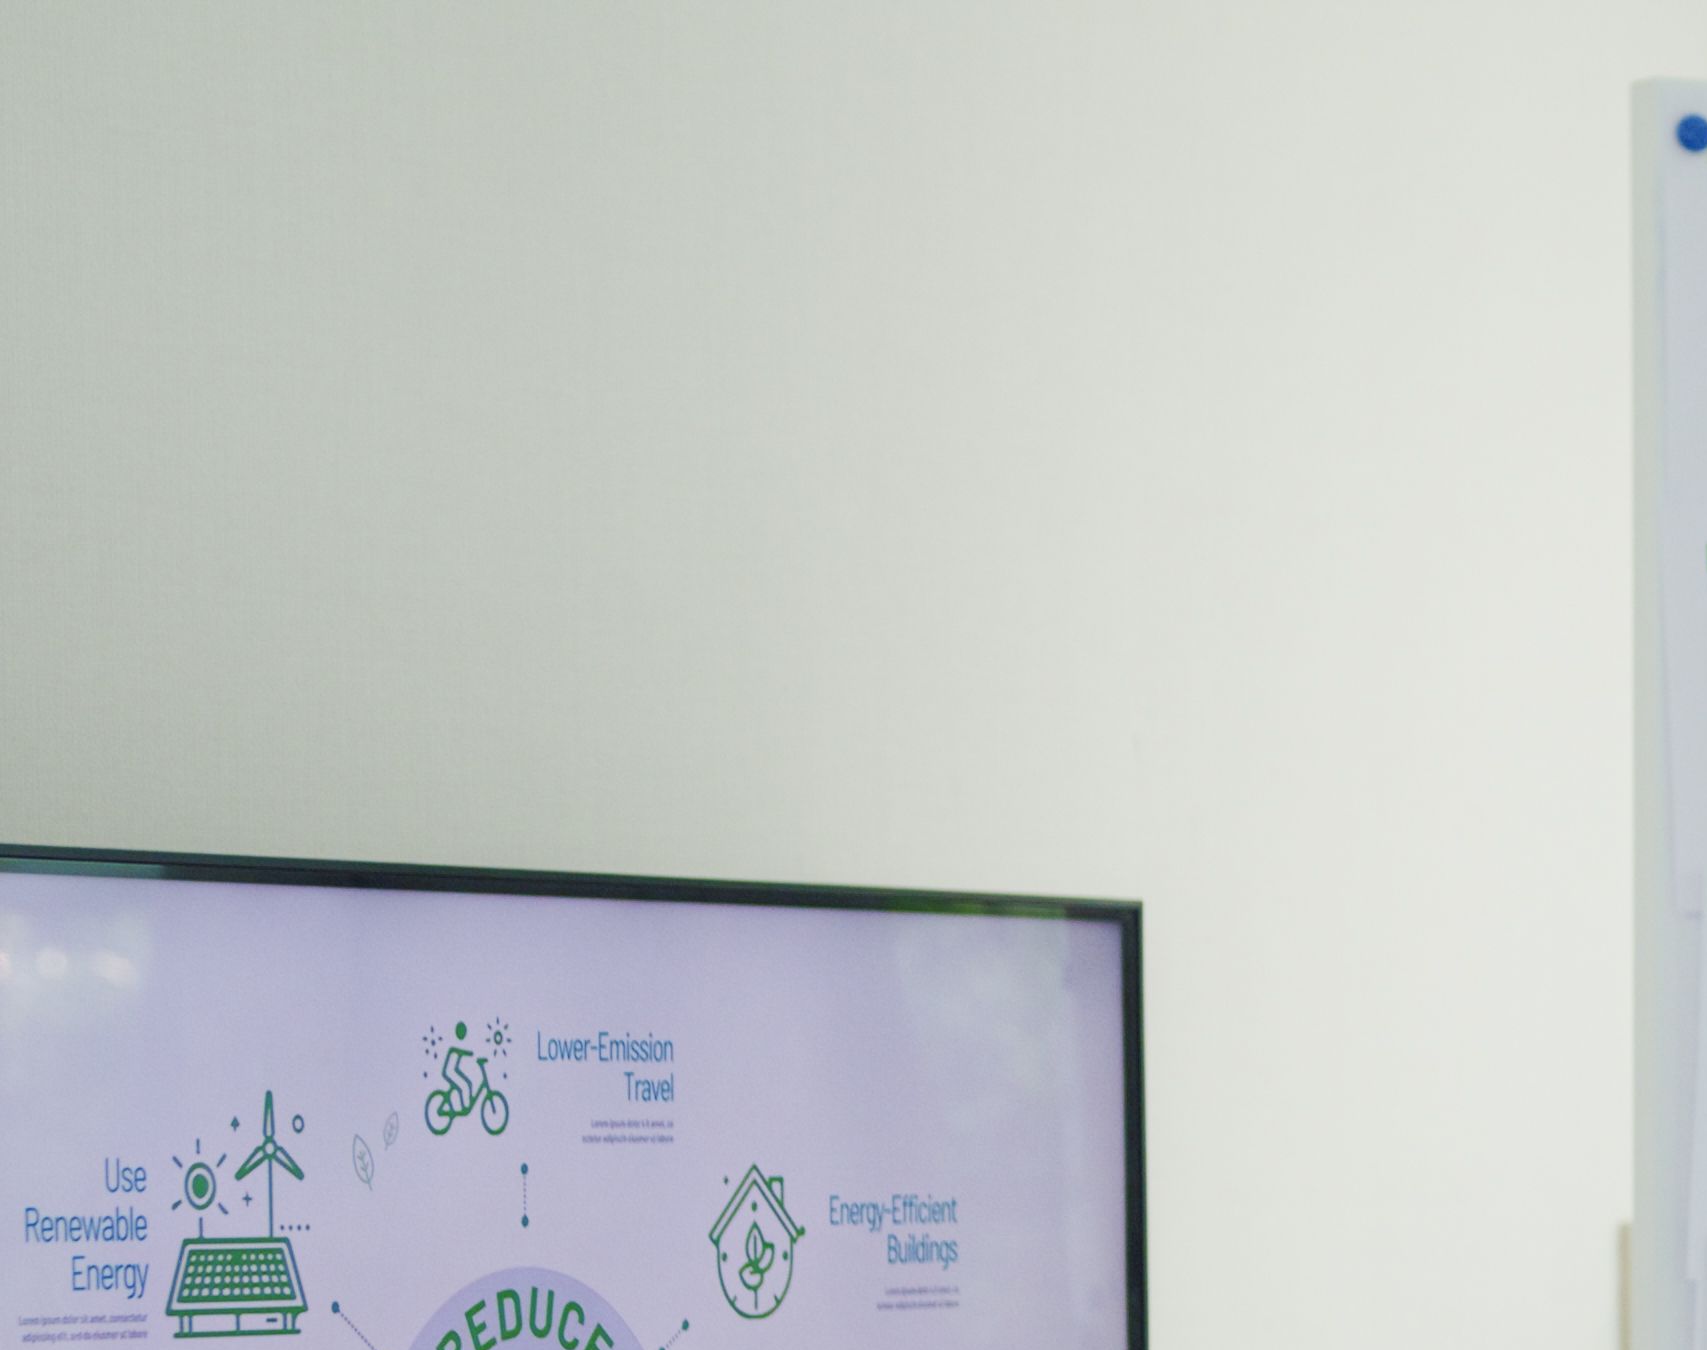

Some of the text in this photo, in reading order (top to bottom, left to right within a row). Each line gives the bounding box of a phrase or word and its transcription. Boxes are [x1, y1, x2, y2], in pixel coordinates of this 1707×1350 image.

[537, 1031, 674, 1063] Lower-Emission
[624, 1072, 674, 1102] Travel
[104, 1157, 147, 1193] Use
[25, 1206, 148, 1243] Renewable
[829, 1194, 958, 1232] Energy-Efficient
[887, 1233, 959, 1271] Buildings
[72, 1255, 149, 1299] Energy
